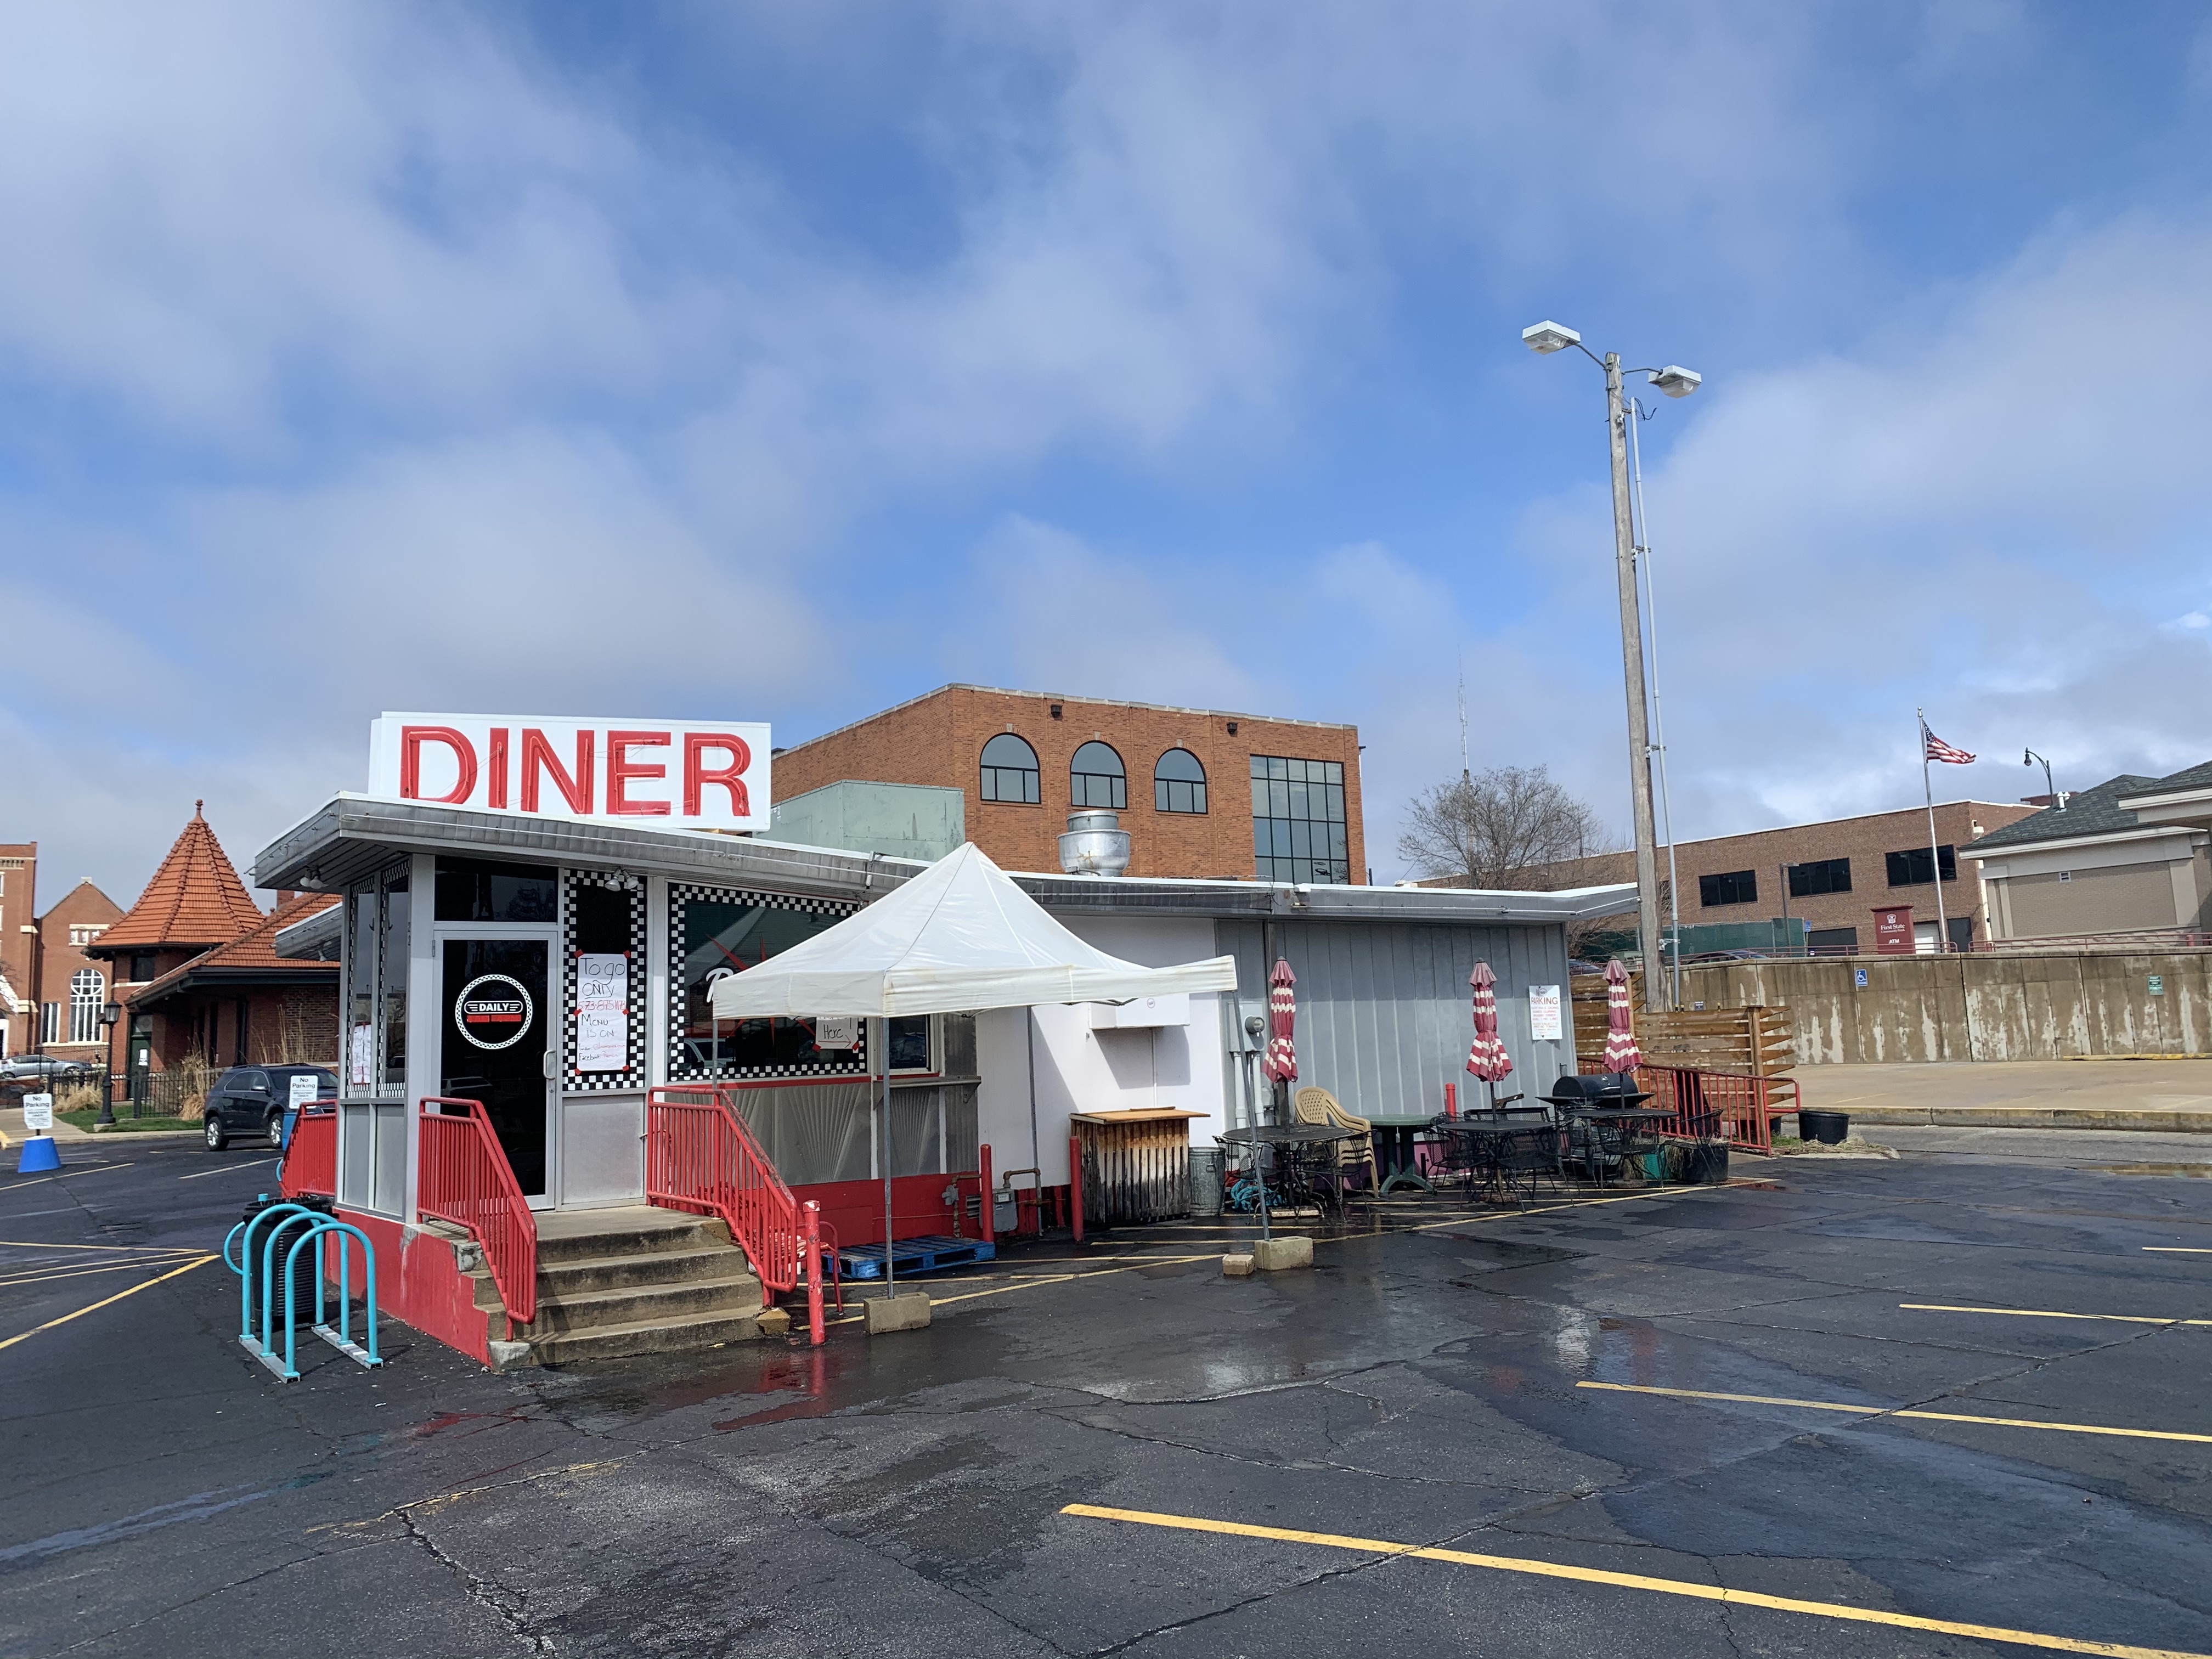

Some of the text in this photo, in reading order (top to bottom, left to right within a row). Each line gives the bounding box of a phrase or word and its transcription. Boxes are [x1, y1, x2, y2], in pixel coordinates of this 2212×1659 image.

[400, 725, 752, 817] DINER
[580, 957, 625, 985] To go
[479, 1003, 509, 1012] DAILY
[1531, 996, 1558, 1005] PARKING
